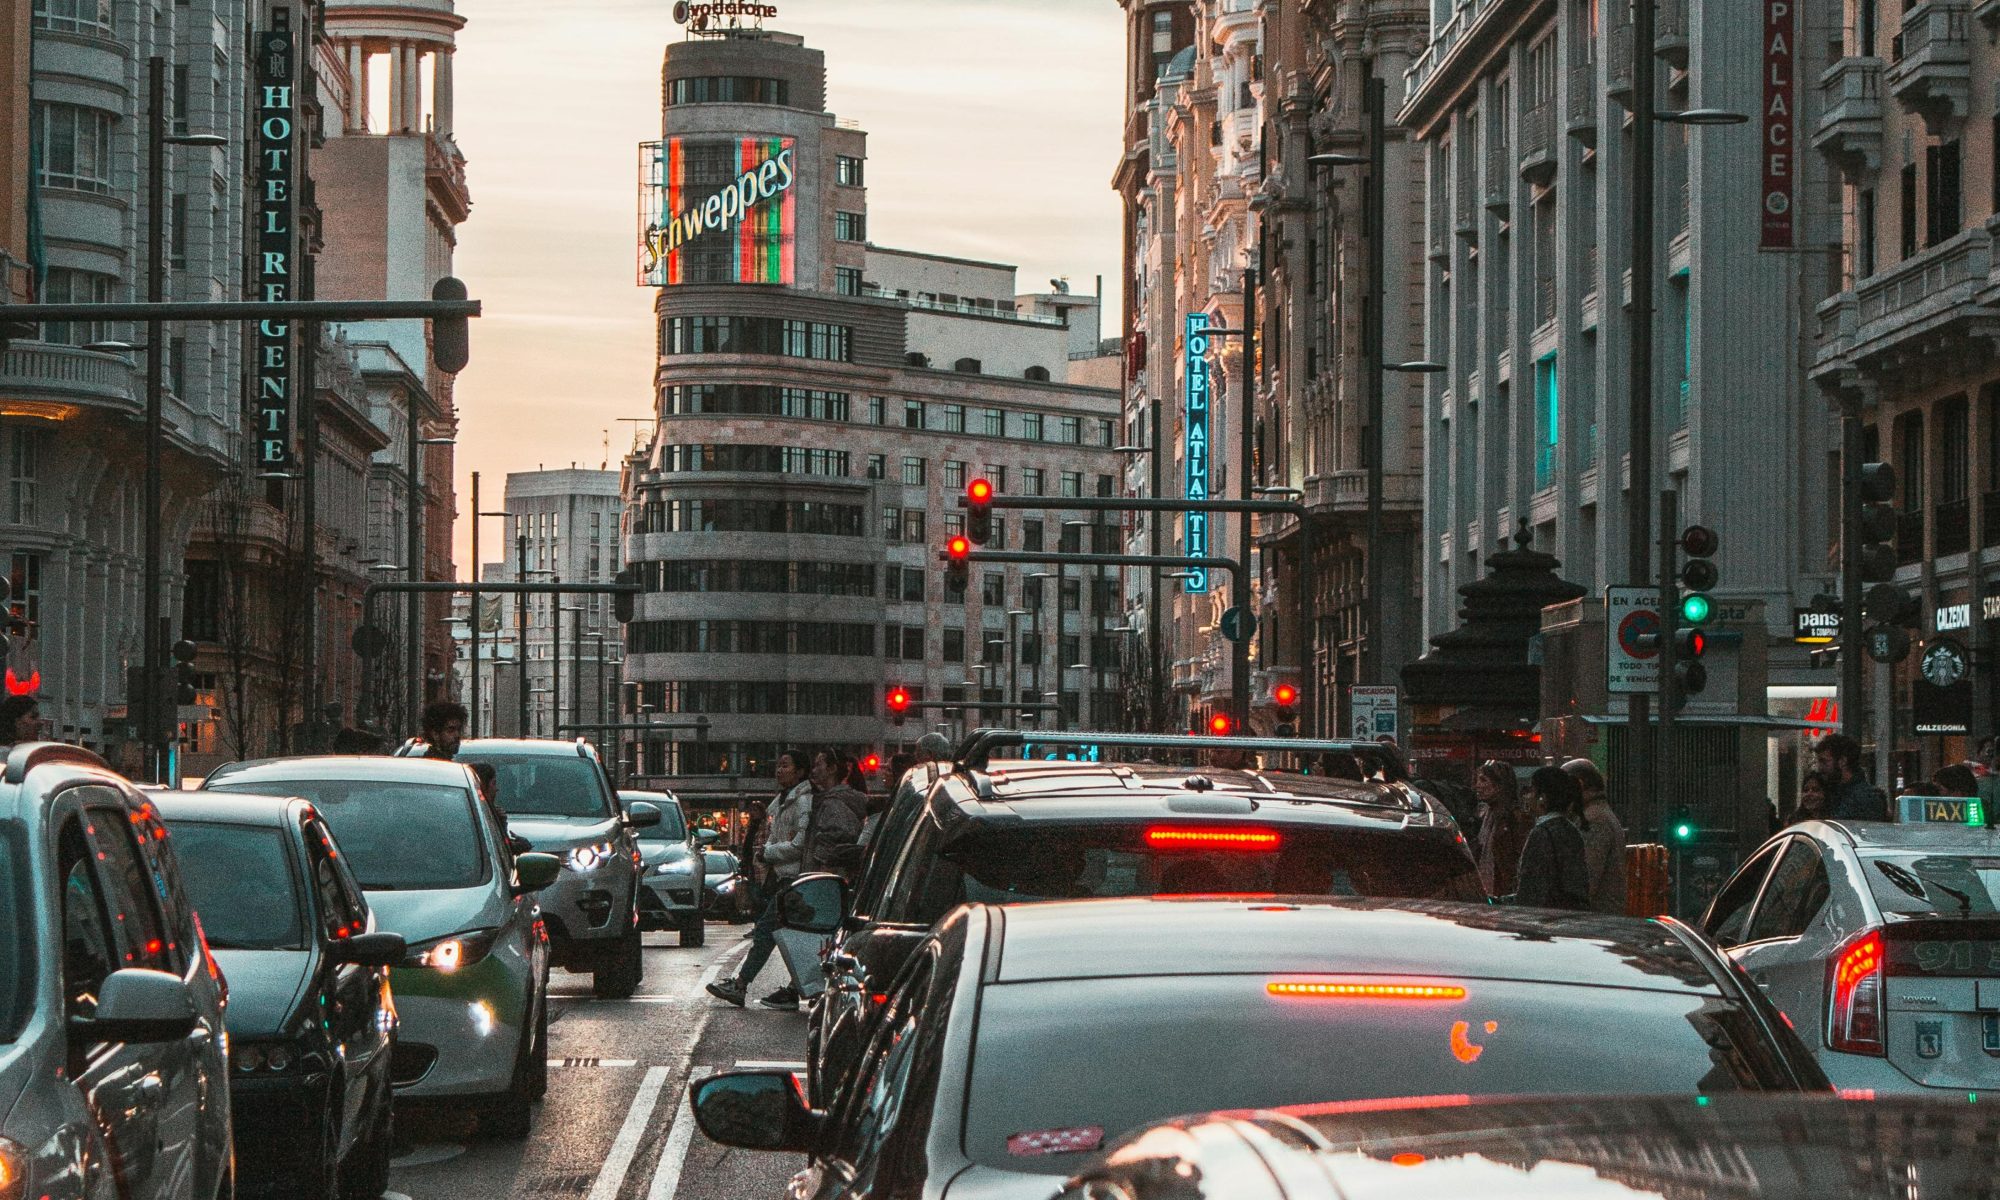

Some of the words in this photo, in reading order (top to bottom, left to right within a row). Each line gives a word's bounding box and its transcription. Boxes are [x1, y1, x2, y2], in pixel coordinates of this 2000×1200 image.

[690, 0, 777, 17] vodafone
[1769, 2, 1788, 176] PALACE
[262, 86, 291, 233] HOTEL
[644, 149, 793, 274] Schweppes
[260, 252, 287, 462] REGENTE
[1189, 318, 1205, 409] HOTEL
[1188, 422, 1205, 588] ATLATIO
[1612, 596, 1628, 606] EN
[1799, 613, 1839, 630] pans
[1936, 604, 1970, 631] CALZEDON
[1619, 662, 1642, 670] TODO
[1647, 662, 1660, 670] TIP
[1916, 724, 1966, 732] CALZEDONIA
[1926, 801, 1967, 821] TAXI
